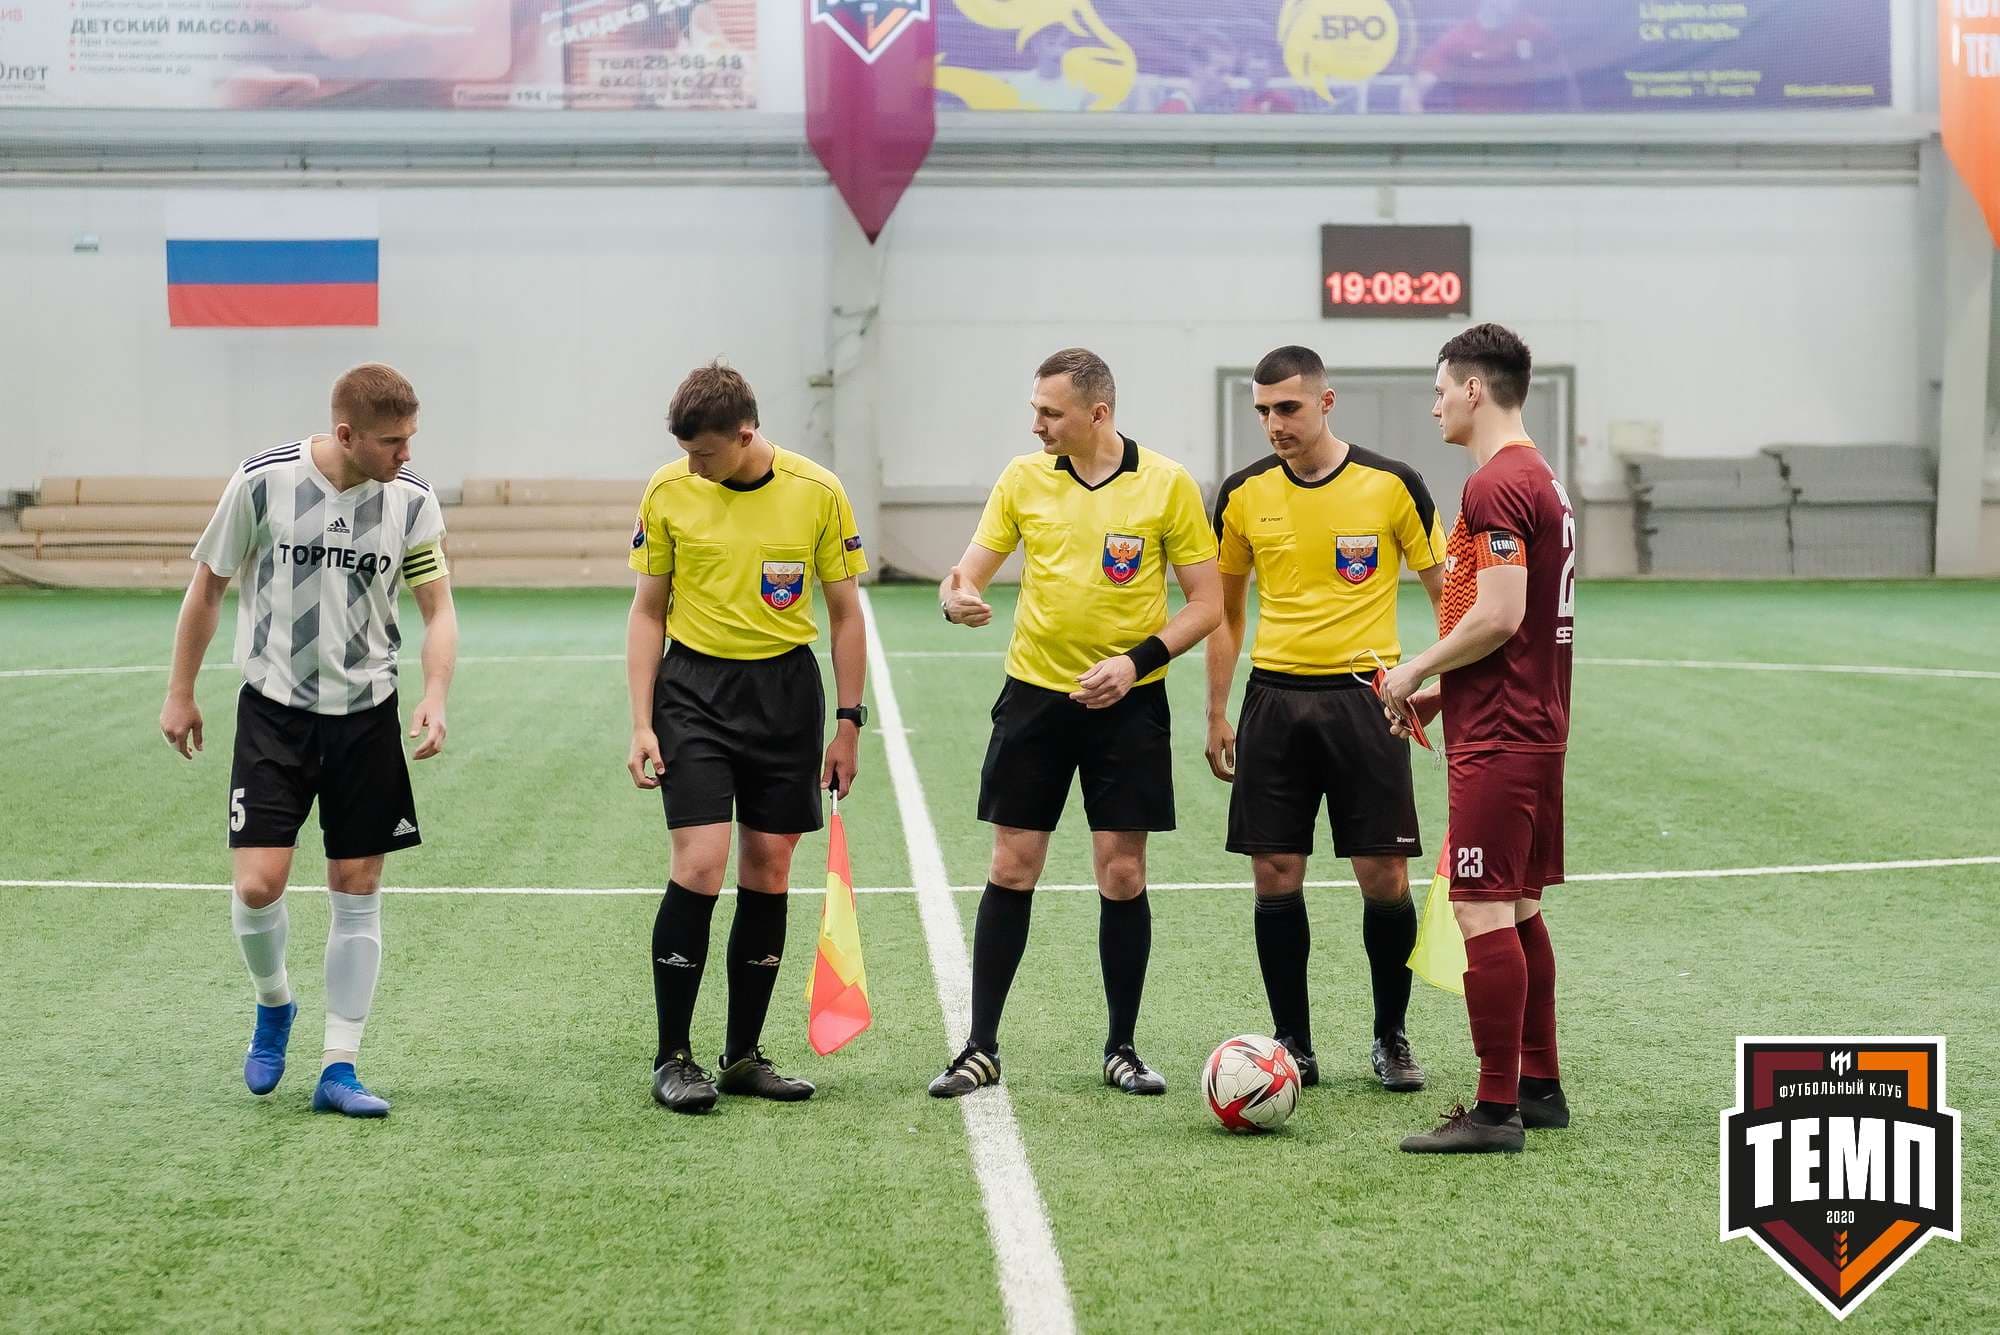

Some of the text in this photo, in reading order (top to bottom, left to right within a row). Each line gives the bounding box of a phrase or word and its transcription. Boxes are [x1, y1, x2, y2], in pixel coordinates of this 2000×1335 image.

[70, 16, 169, 34] ДЕТСКИЙ
[1326, 272, 1461, 304] 19:08:20
[279, 544, 391, 575] ТОРПЕДО
[1491, 540, 1517, 551] ТЕМП
[230, 788, 246, 832] 5
[1457, 847, 1484, 878] 23
